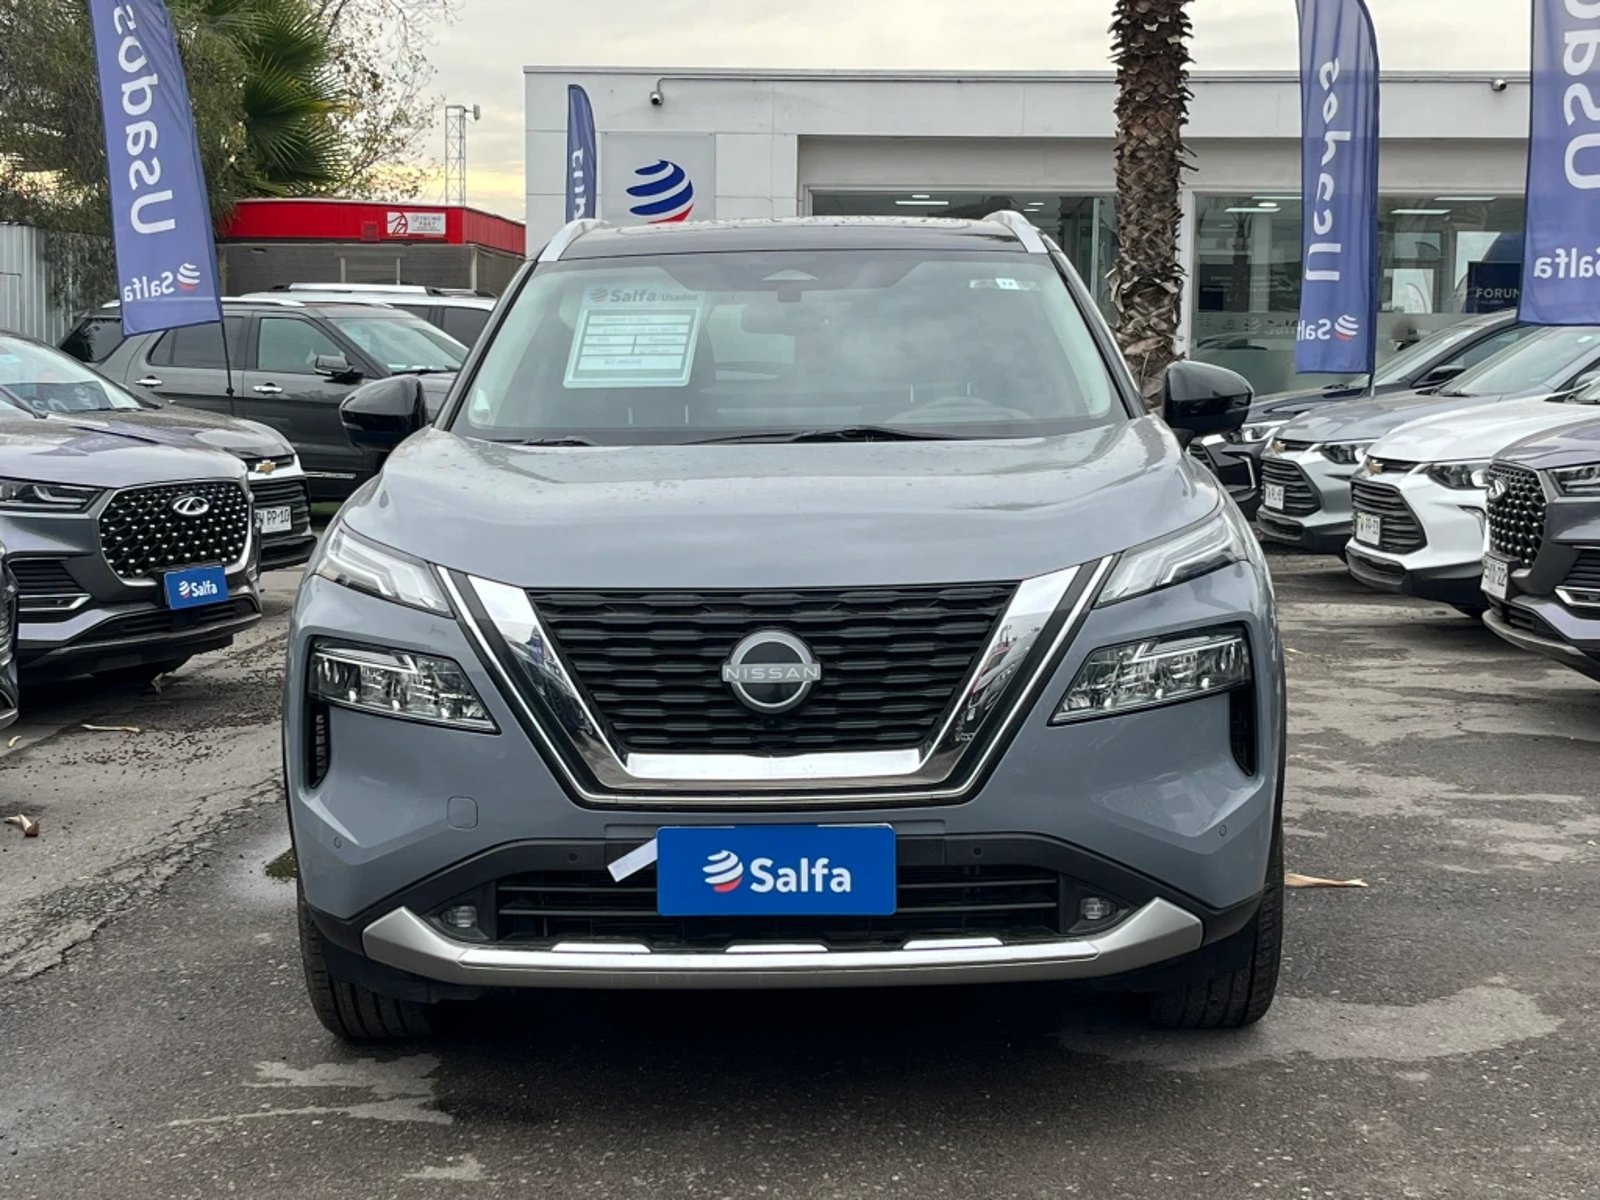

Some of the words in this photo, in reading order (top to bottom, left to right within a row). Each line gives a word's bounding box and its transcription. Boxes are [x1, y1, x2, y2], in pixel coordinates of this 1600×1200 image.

[610, 289, 657, 302] Salfa
[190, 580, 218, 597] Salfa
[726, 667, 818, 679] NISSAN
[750, 857, 851, 893] Salfa
